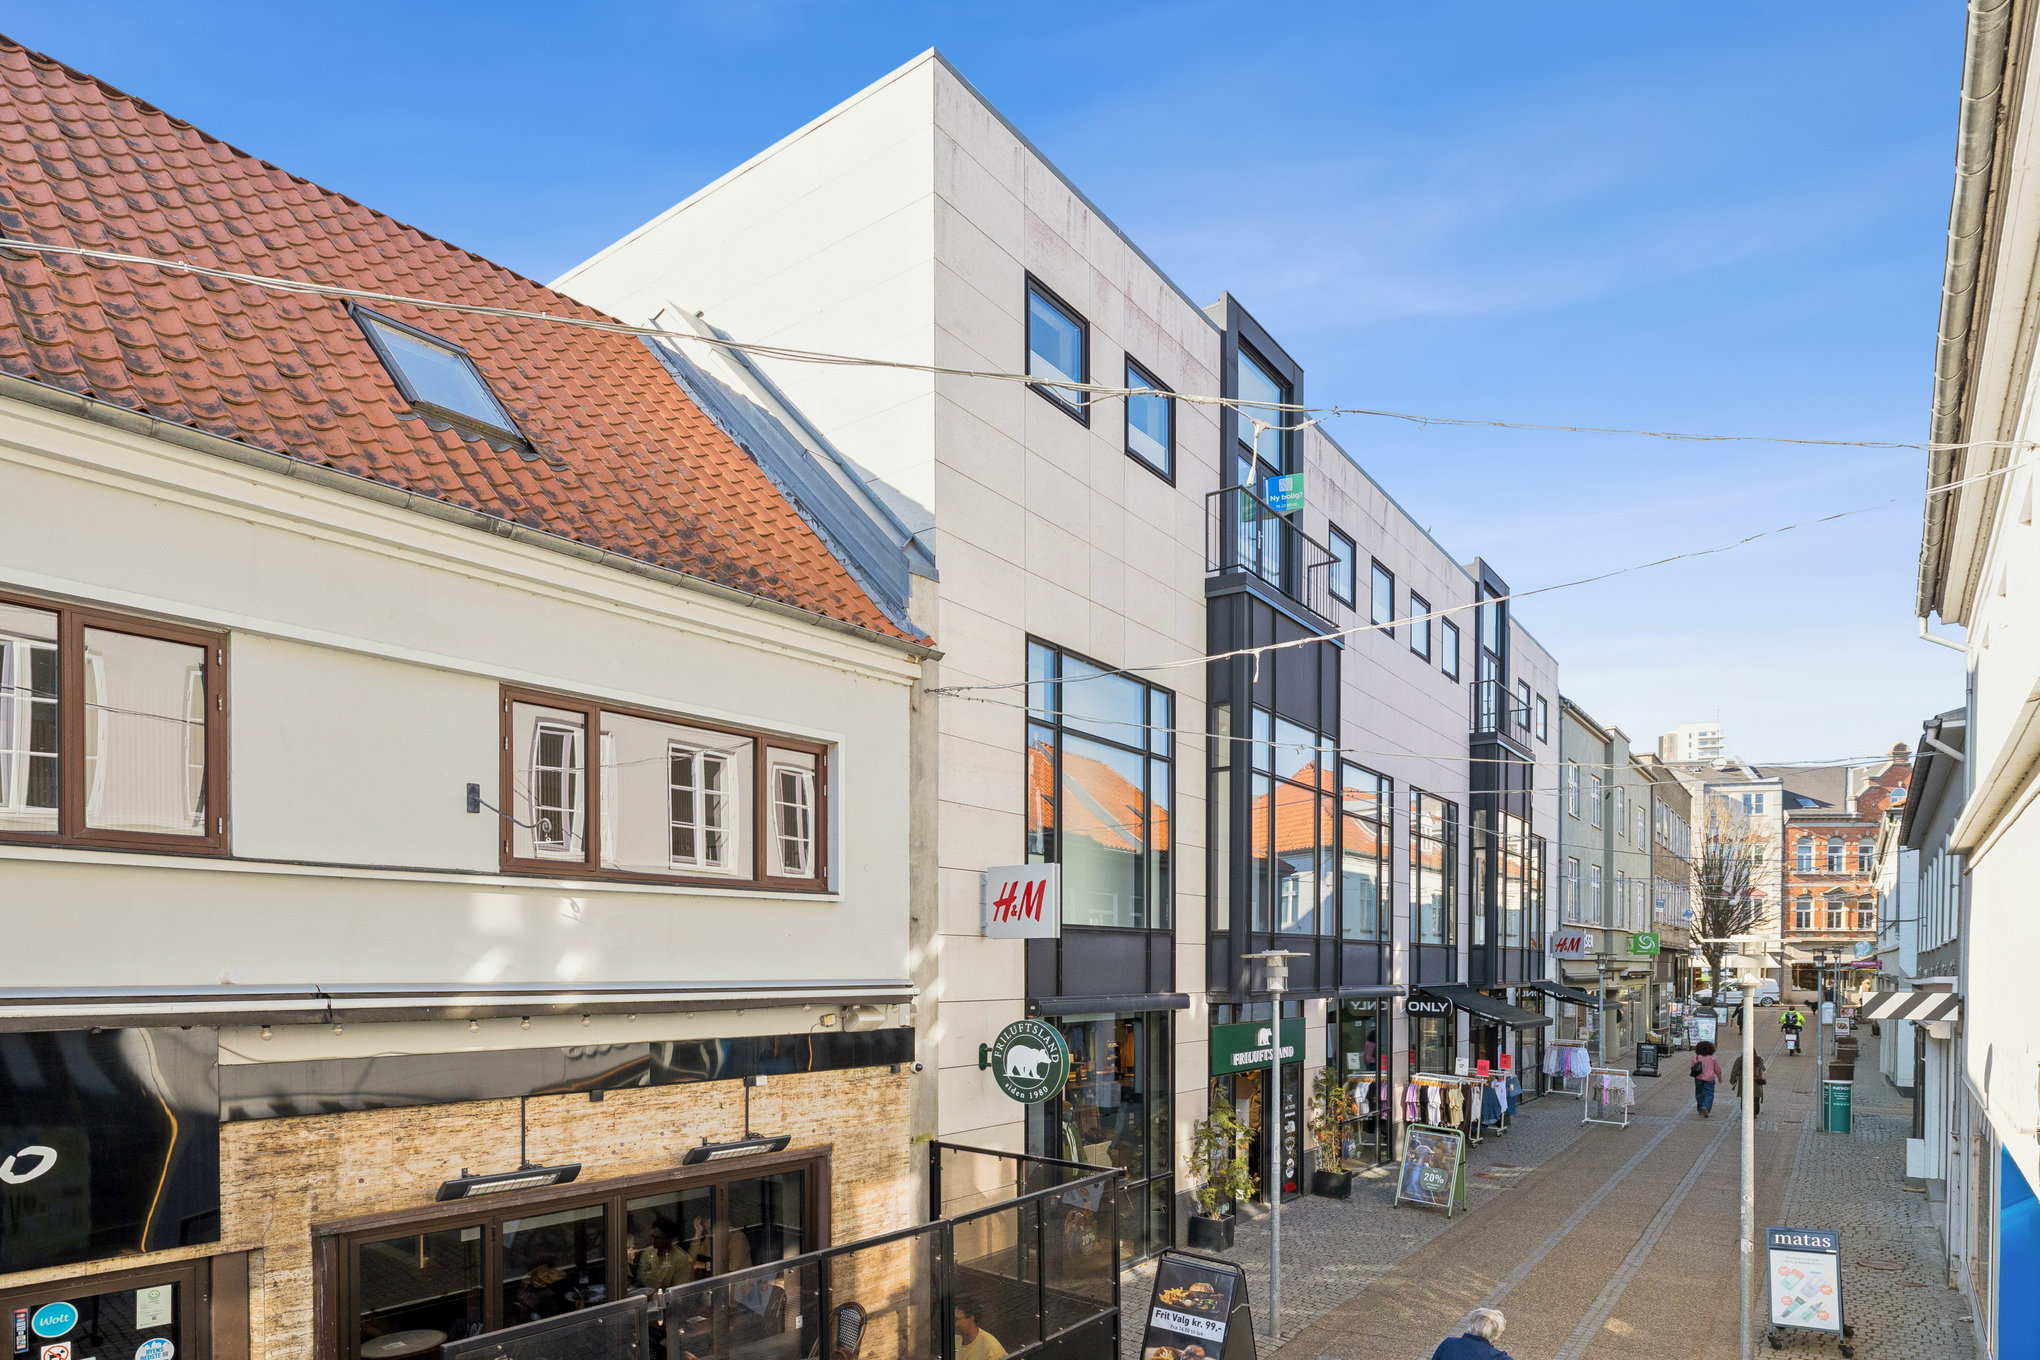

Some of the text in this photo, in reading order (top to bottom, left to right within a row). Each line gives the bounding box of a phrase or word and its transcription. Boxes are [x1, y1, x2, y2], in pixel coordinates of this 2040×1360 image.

[1281, 491, 1302, 500] bolig?
[993, 879, 1046, 923] H&M
[1555, 937, 1581, 953] H&M
[1408, 1001, 1448, 1013] ONLY
[994, 1022, 1060, 1063] FRILUFTSLAND
[1231, 1046, 1295, 1066] FRILUFTSAND
[1004, 1082, 1049, 1099] siden 1980
[1423, 1172, 1444, 1184] 20%
[1774, 1233, 1832, 1248] matas
[40, 1313, 70, 1327] Wolt
[1155, 1309, 1222, 1333] Frit Valg kr. 99,-
